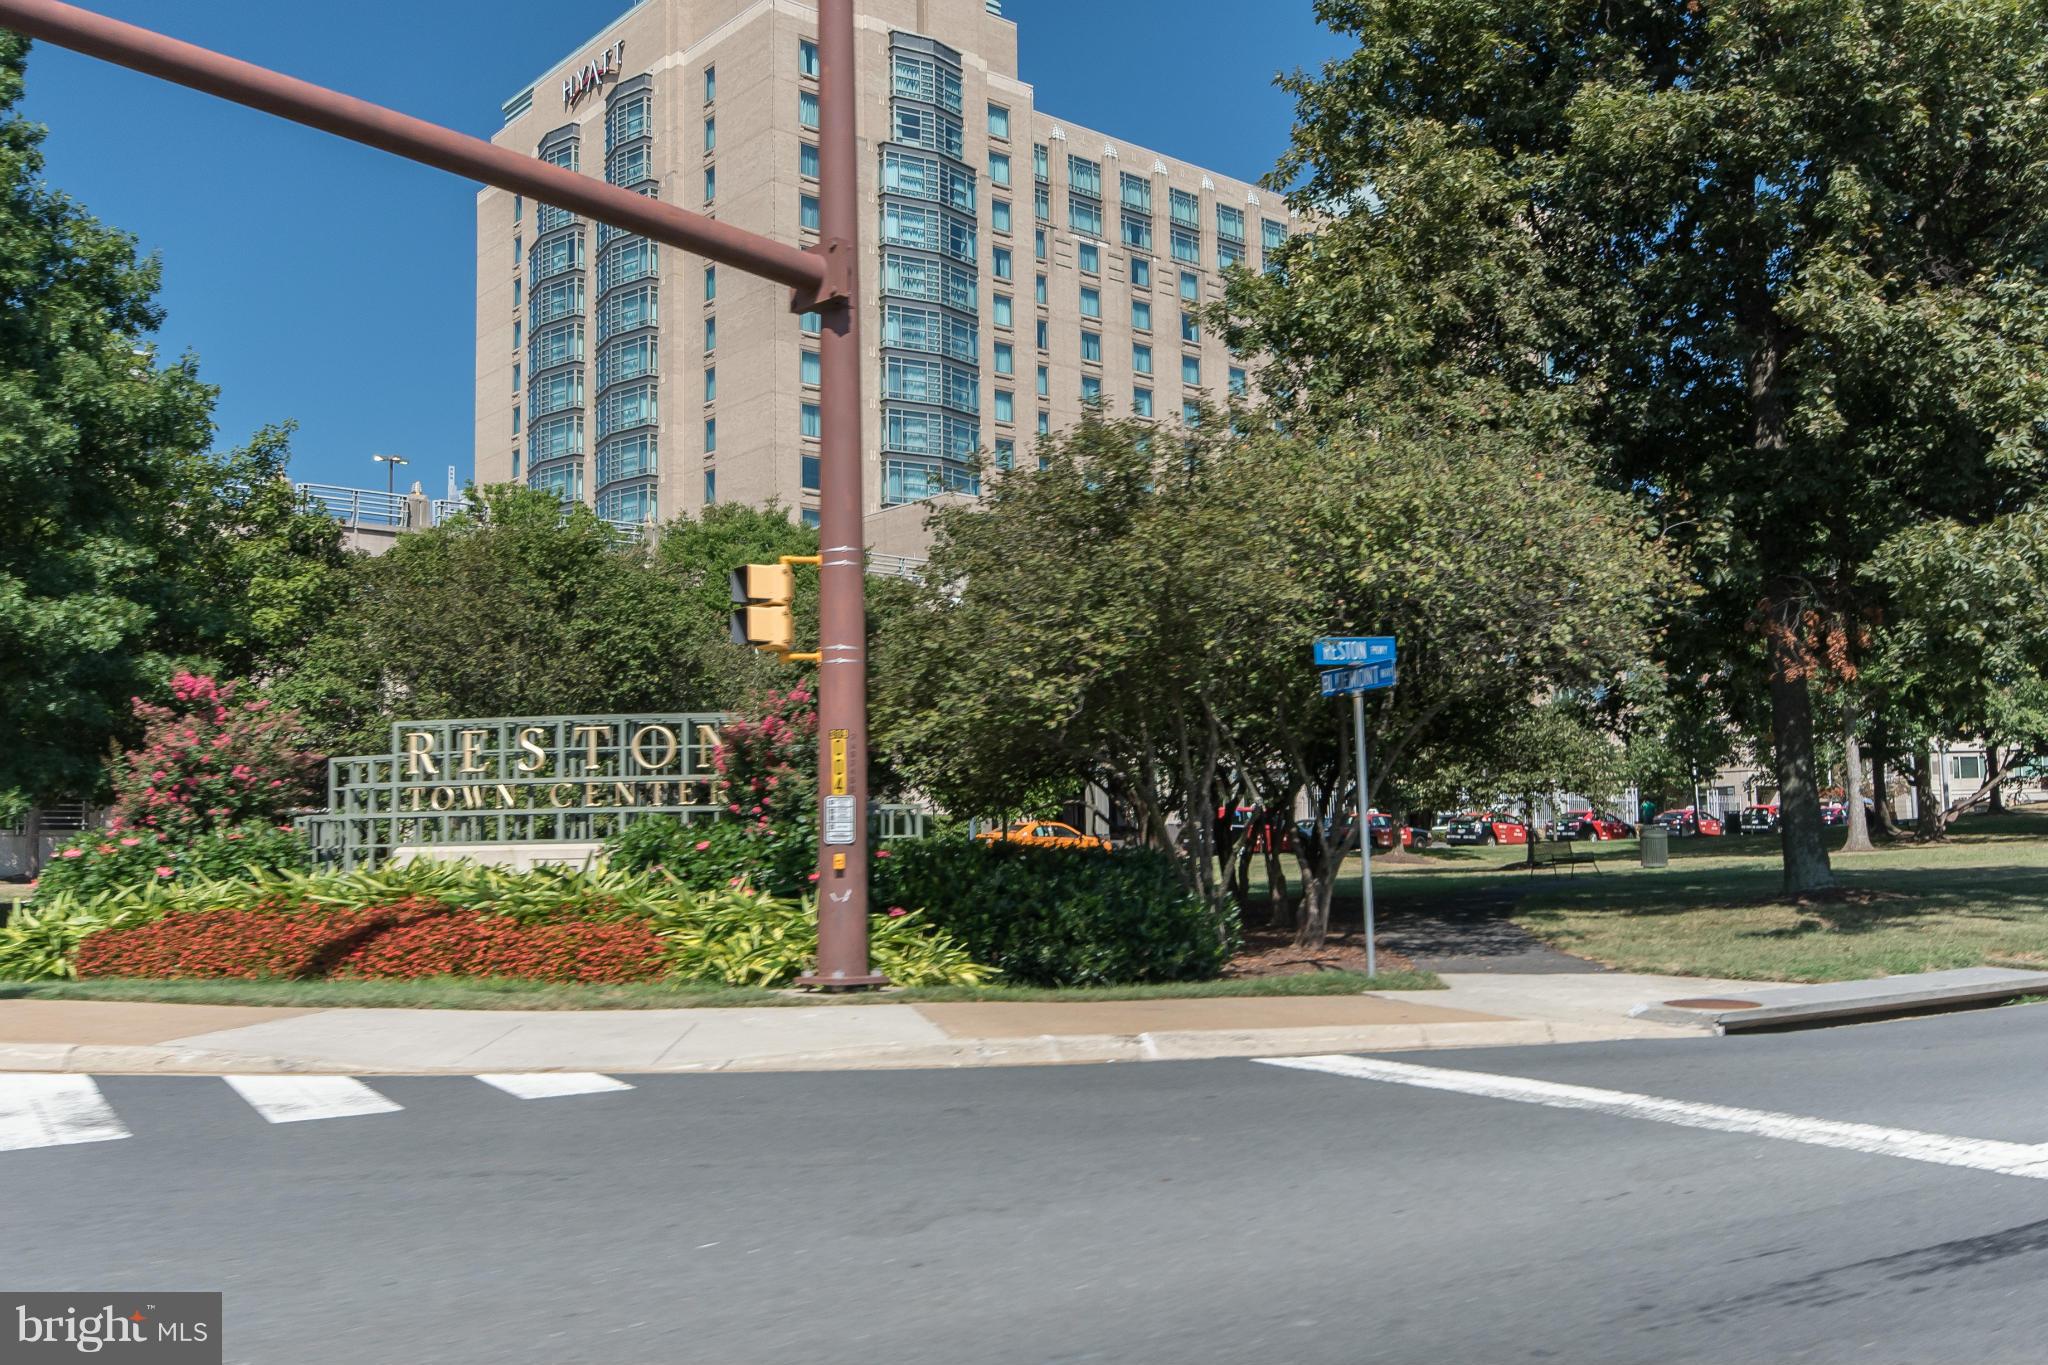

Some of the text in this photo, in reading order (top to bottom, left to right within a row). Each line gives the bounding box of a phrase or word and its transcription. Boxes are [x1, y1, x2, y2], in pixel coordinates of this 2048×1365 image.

[562, 39, 624, 102] HYATT
[1322, 641, 1367, 661] RESTON
[405, 724, 731, 776] RESTON
[408, 780, 730, 812] TOWN CENTER
